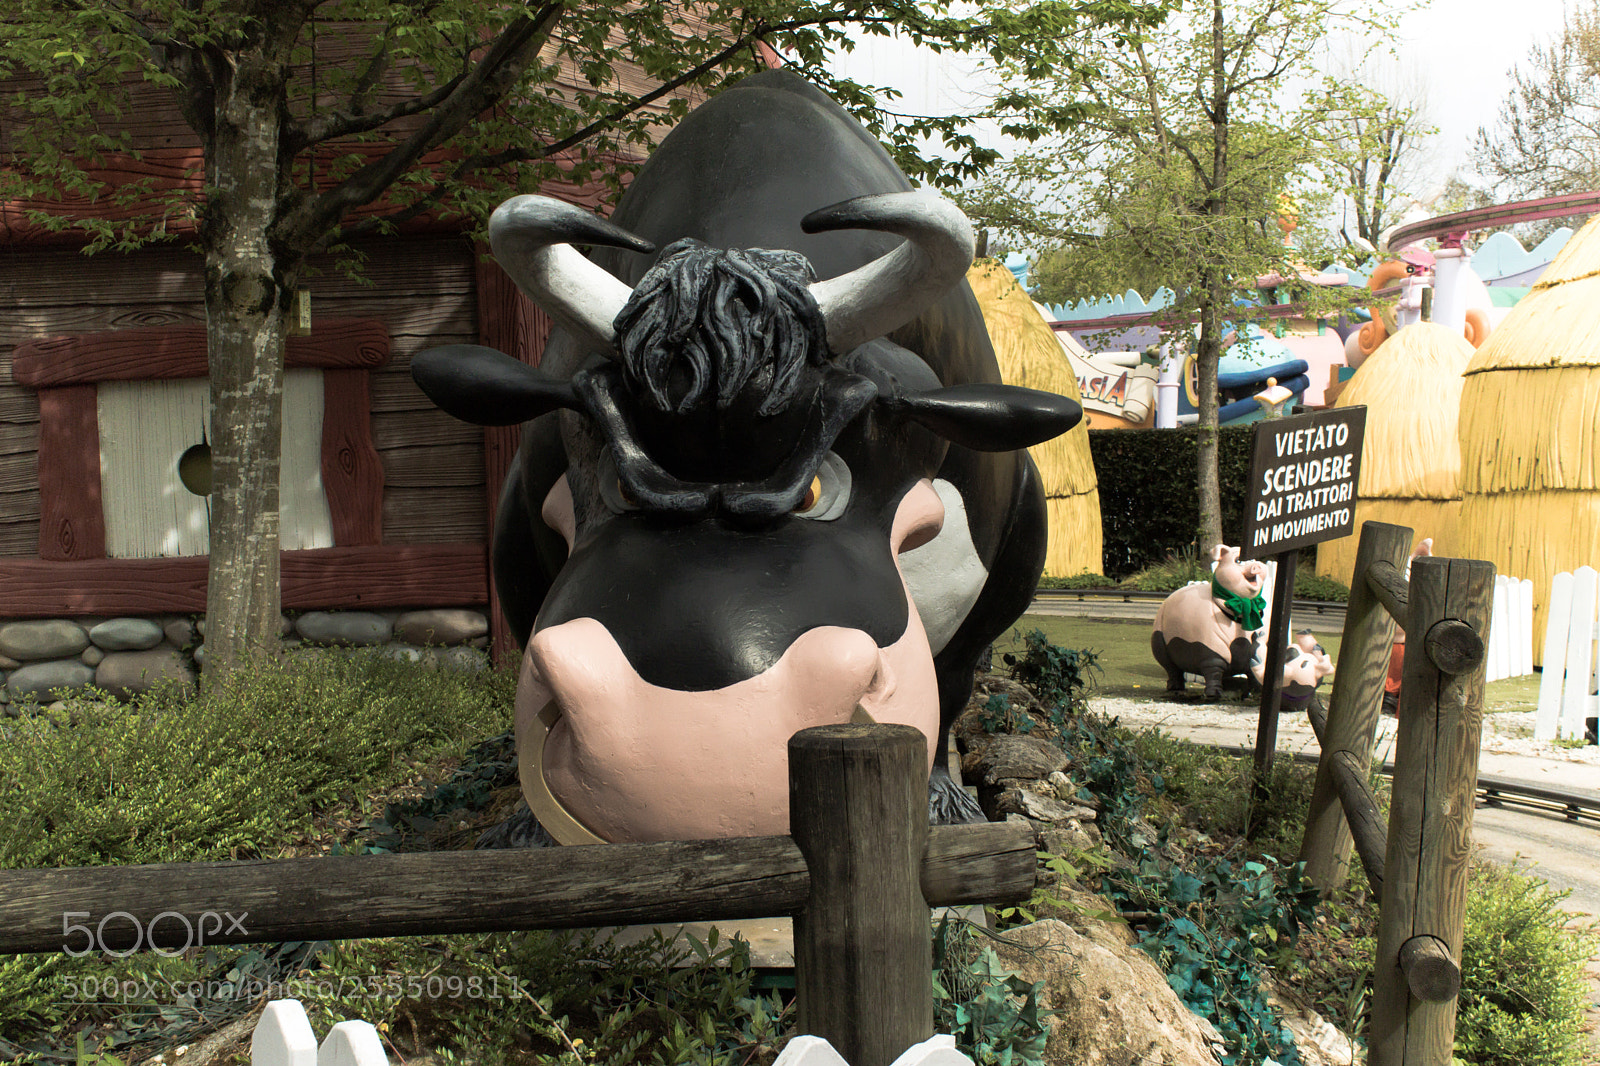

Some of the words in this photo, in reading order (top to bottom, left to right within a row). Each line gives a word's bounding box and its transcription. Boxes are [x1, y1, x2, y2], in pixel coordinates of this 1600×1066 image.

[1275, 423, 1349, 457] VIETATO
[1261, 453, 1354, 496] SCENDERE
[1256, 497, 1283, 521] DAI
[1286, 481, 1354, 514] TRATTORI
[1253, 527, 1269, 547] IN
[1271, 508, 1350, 543] MOVIMENTO
